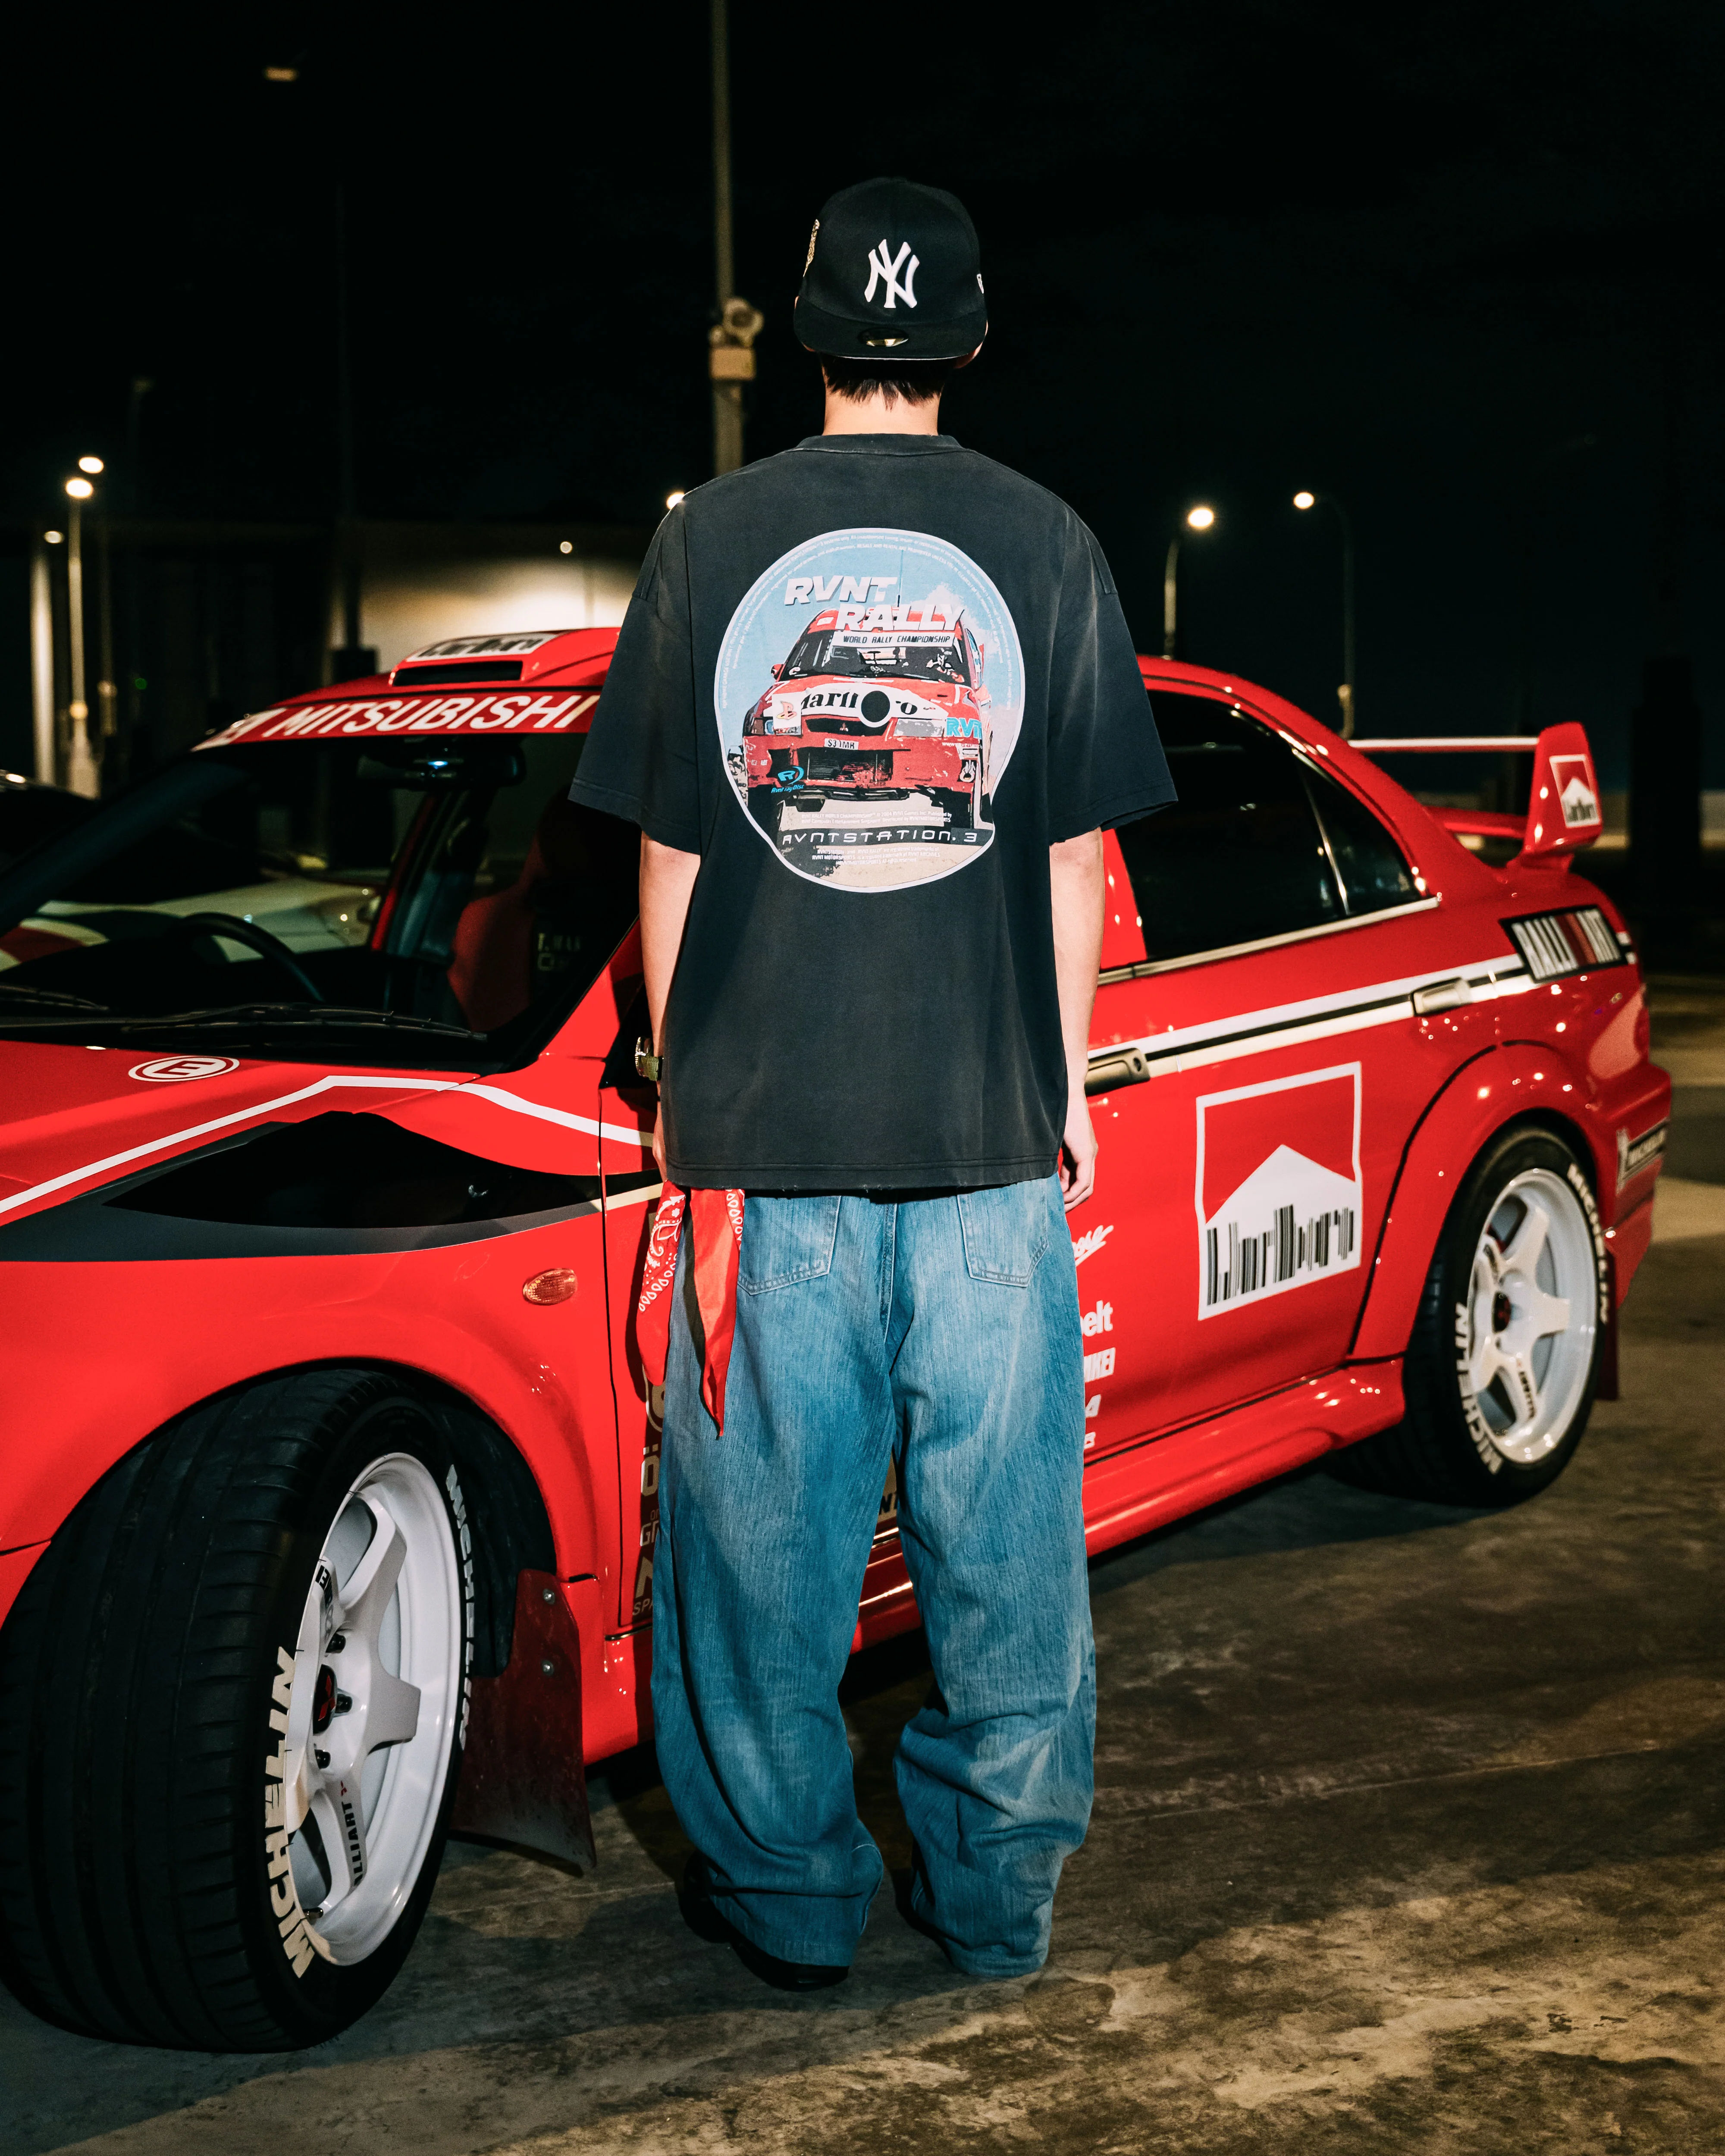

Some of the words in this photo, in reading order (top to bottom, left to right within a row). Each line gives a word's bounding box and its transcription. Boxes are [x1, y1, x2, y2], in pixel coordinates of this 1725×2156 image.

[864, 239, 919, 308] NY
[784, 575, 898, 606] RVNT
[835, 602, 965, 631] RALLY
[843, 635, 868, 643] WORLD
[262, 695, 599, 738] MITSUBISHI
[264, 1645, 316, 1979] MICHELIN
